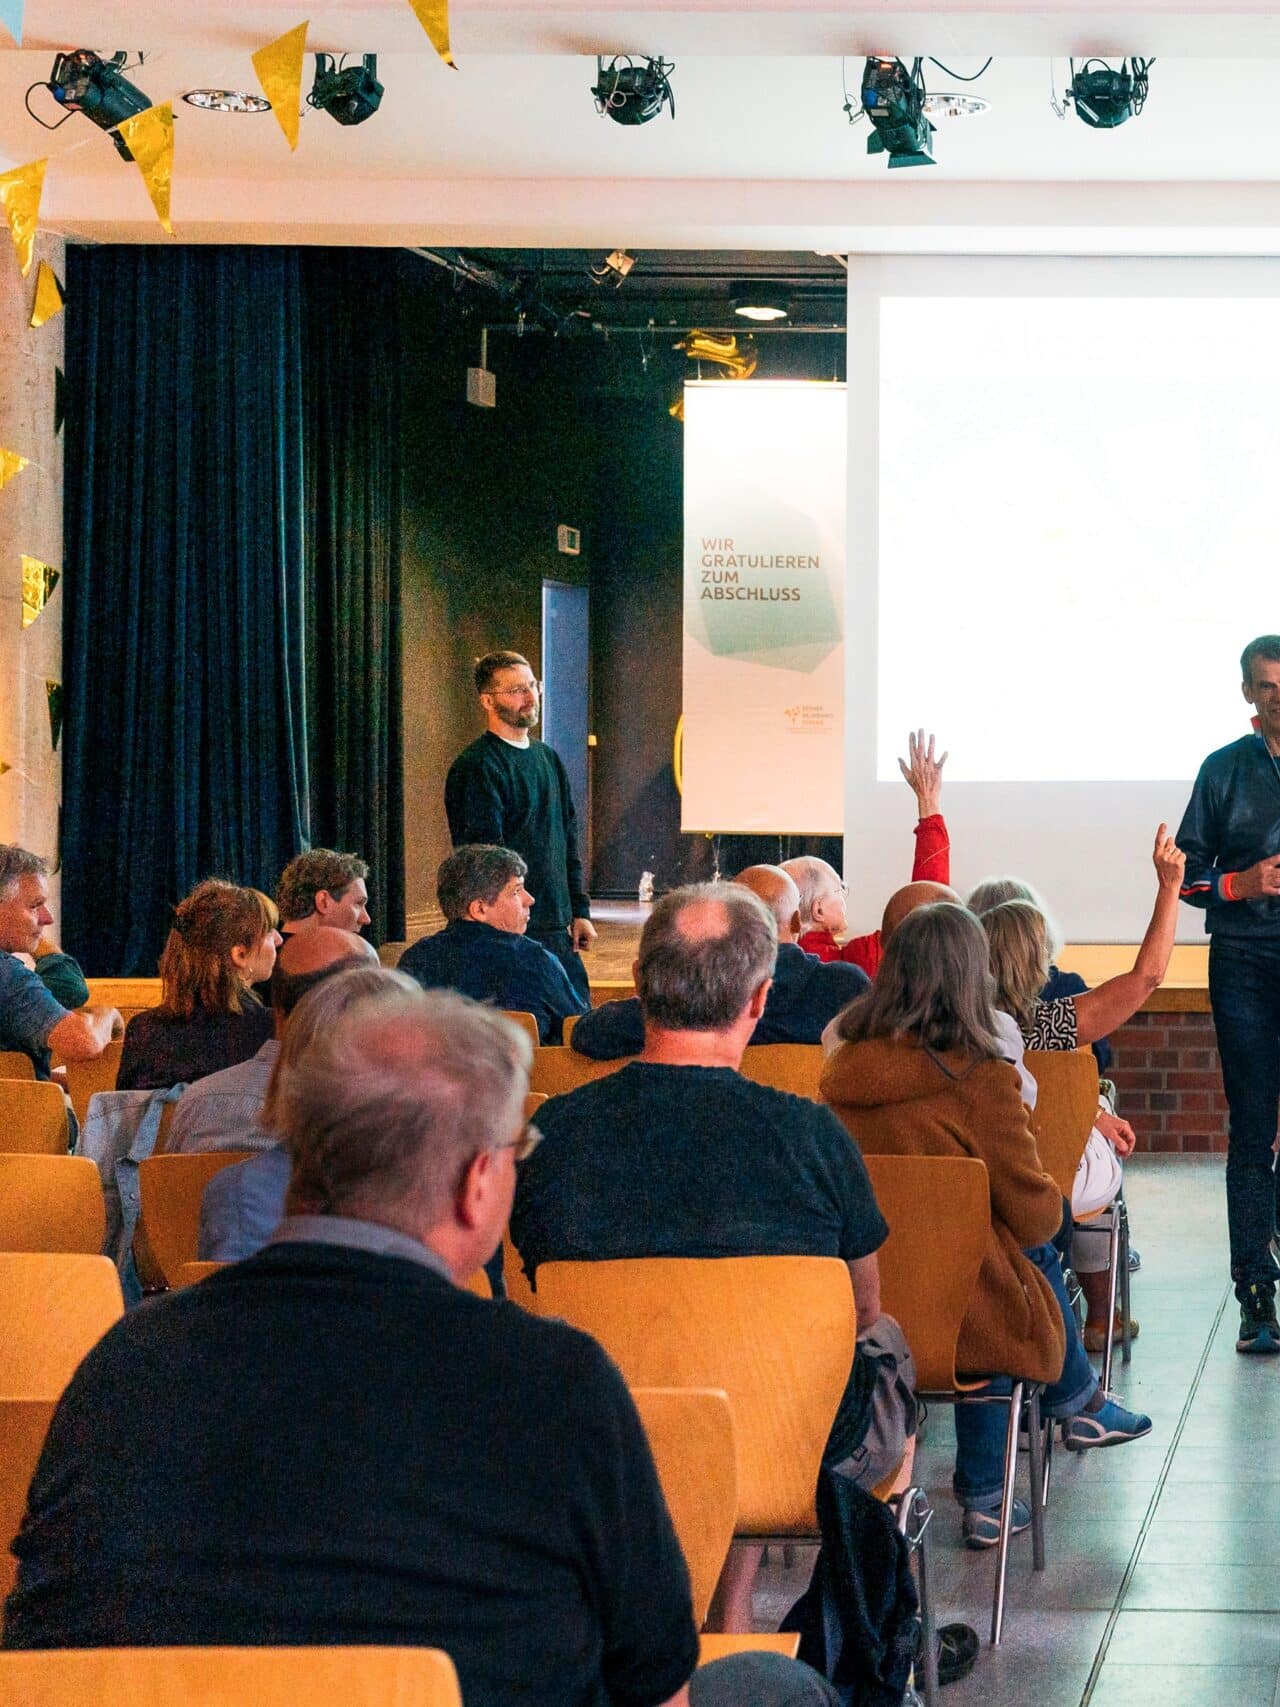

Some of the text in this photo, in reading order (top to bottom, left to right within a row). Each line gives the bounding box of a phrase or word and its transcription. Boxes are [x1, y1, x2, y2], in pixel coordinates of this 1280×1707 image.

[702, 538, 735, 551] WIR
[701, 554, 820, 569] GRATULIEREN
[701, 570, 740, 584] ZUM
[700, 586, 801, 601] ABSCHLUSS
